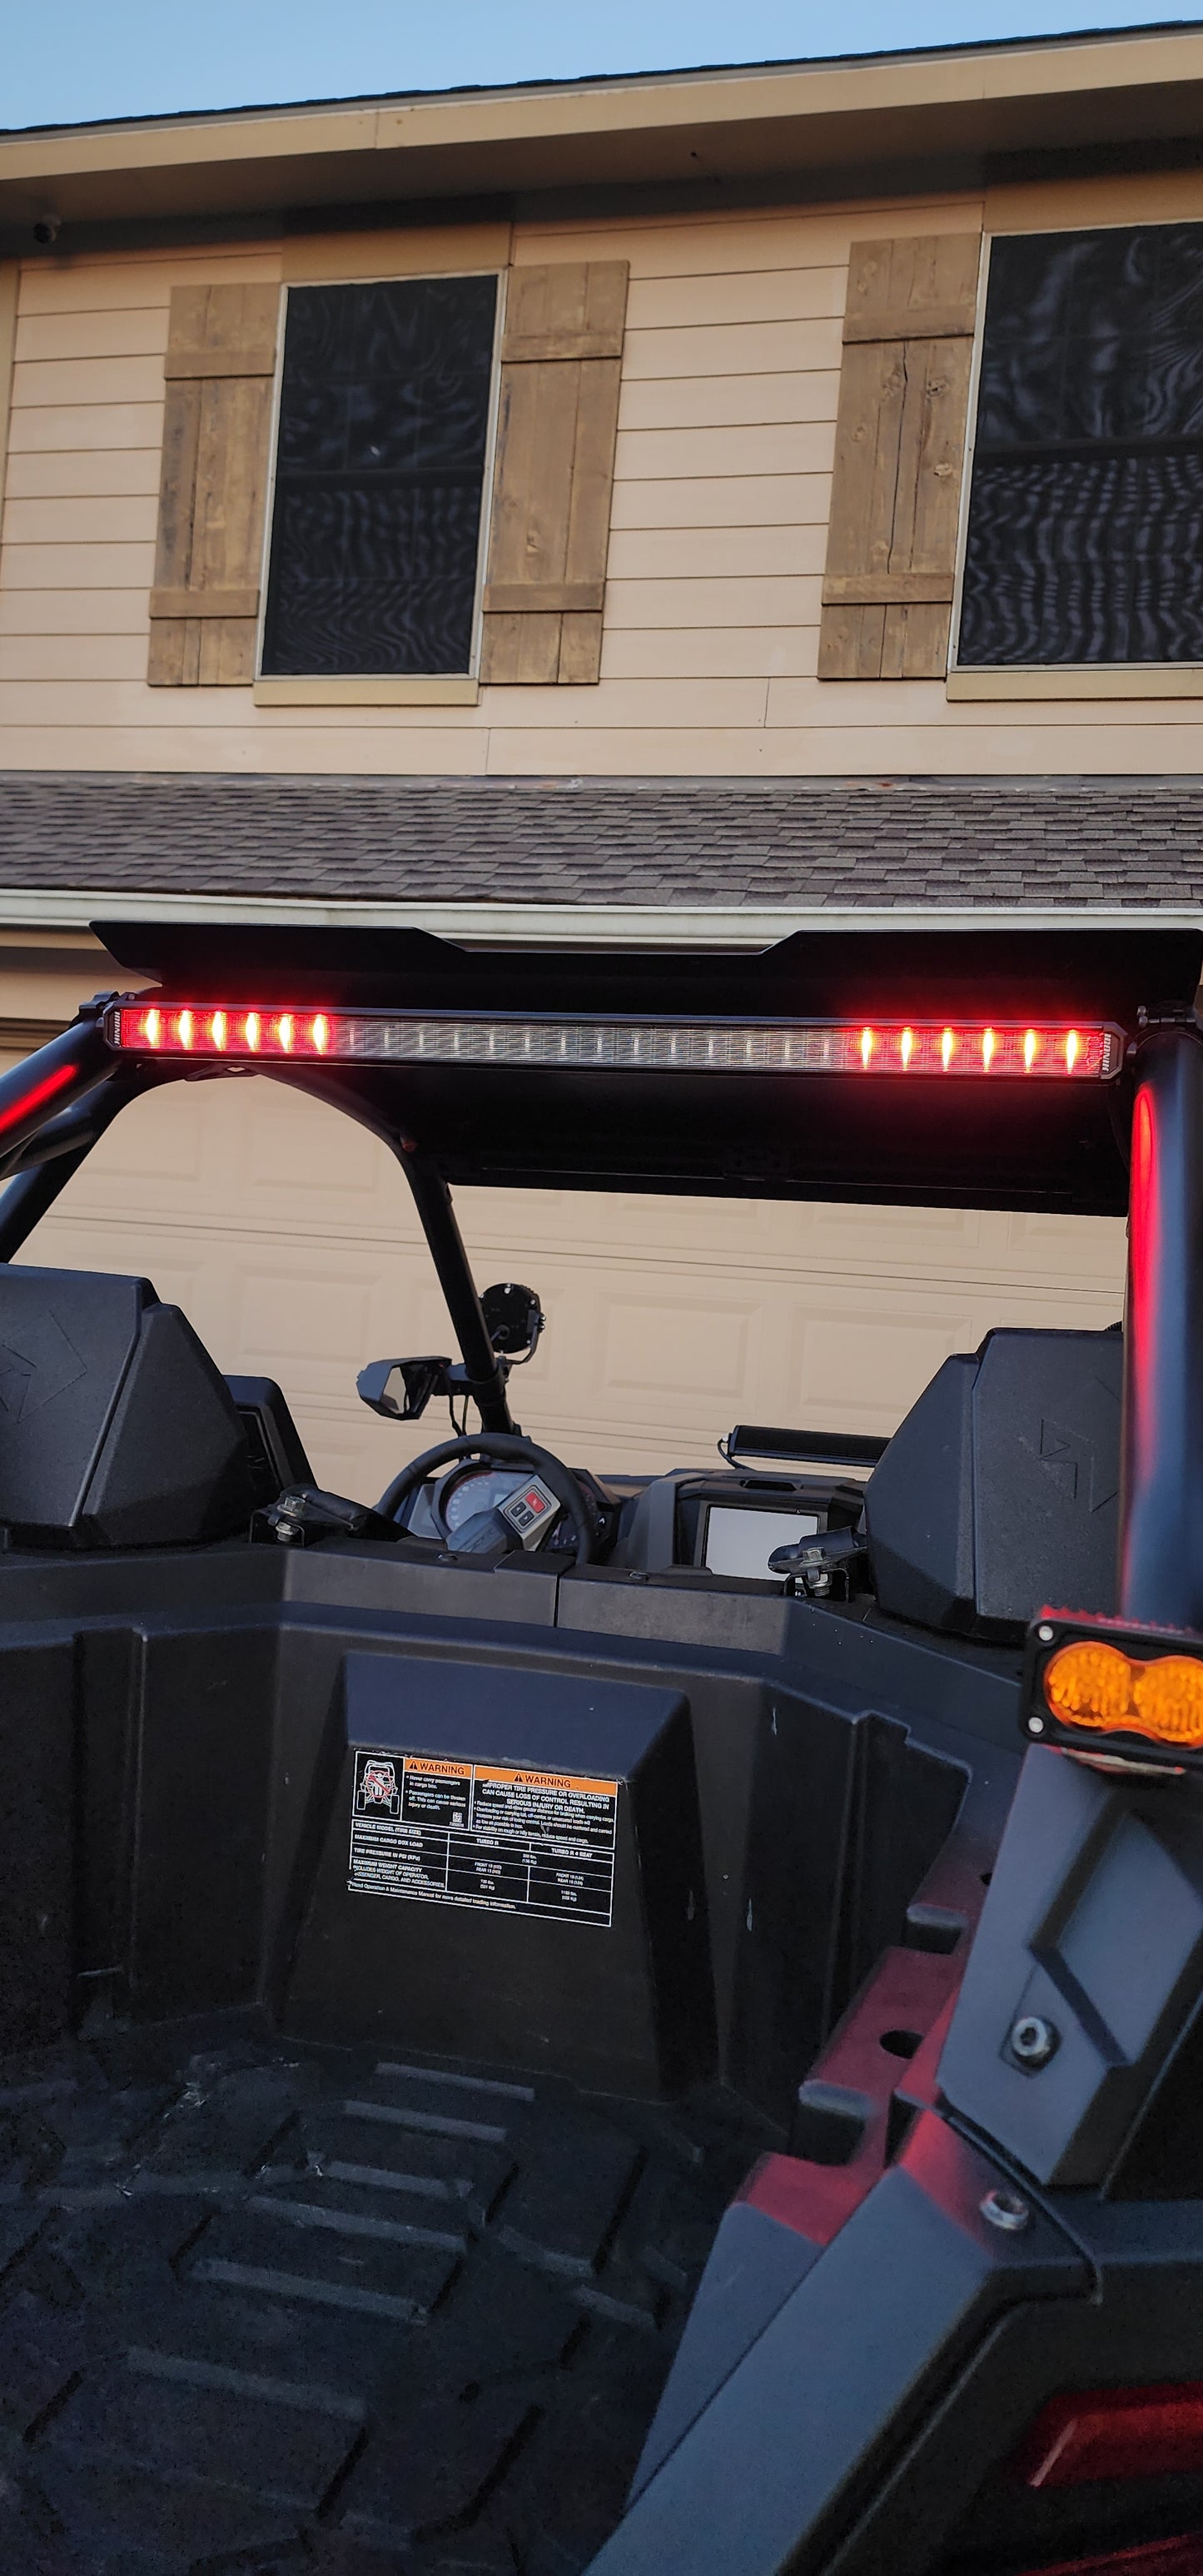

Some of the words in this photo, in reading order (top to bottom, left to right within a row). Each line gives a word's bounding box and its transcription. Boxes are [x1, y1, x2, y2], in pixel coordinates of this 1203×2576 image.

[420, 1763, 465, 1775] WARNING
[525, 1775, 570, 1788] WARNING
[527, 1788, 558, 1796] PRESSURE
[568, 1793, 609, 1803] OVERLOADING
[541, 1797, 569, 1805] CONTROL
[570, 1800, 602, 1808] RESULTING
[355, 1834, 379, 1842] MAXIMUM
[365, 1849, 391, 1858] PRESSURE
